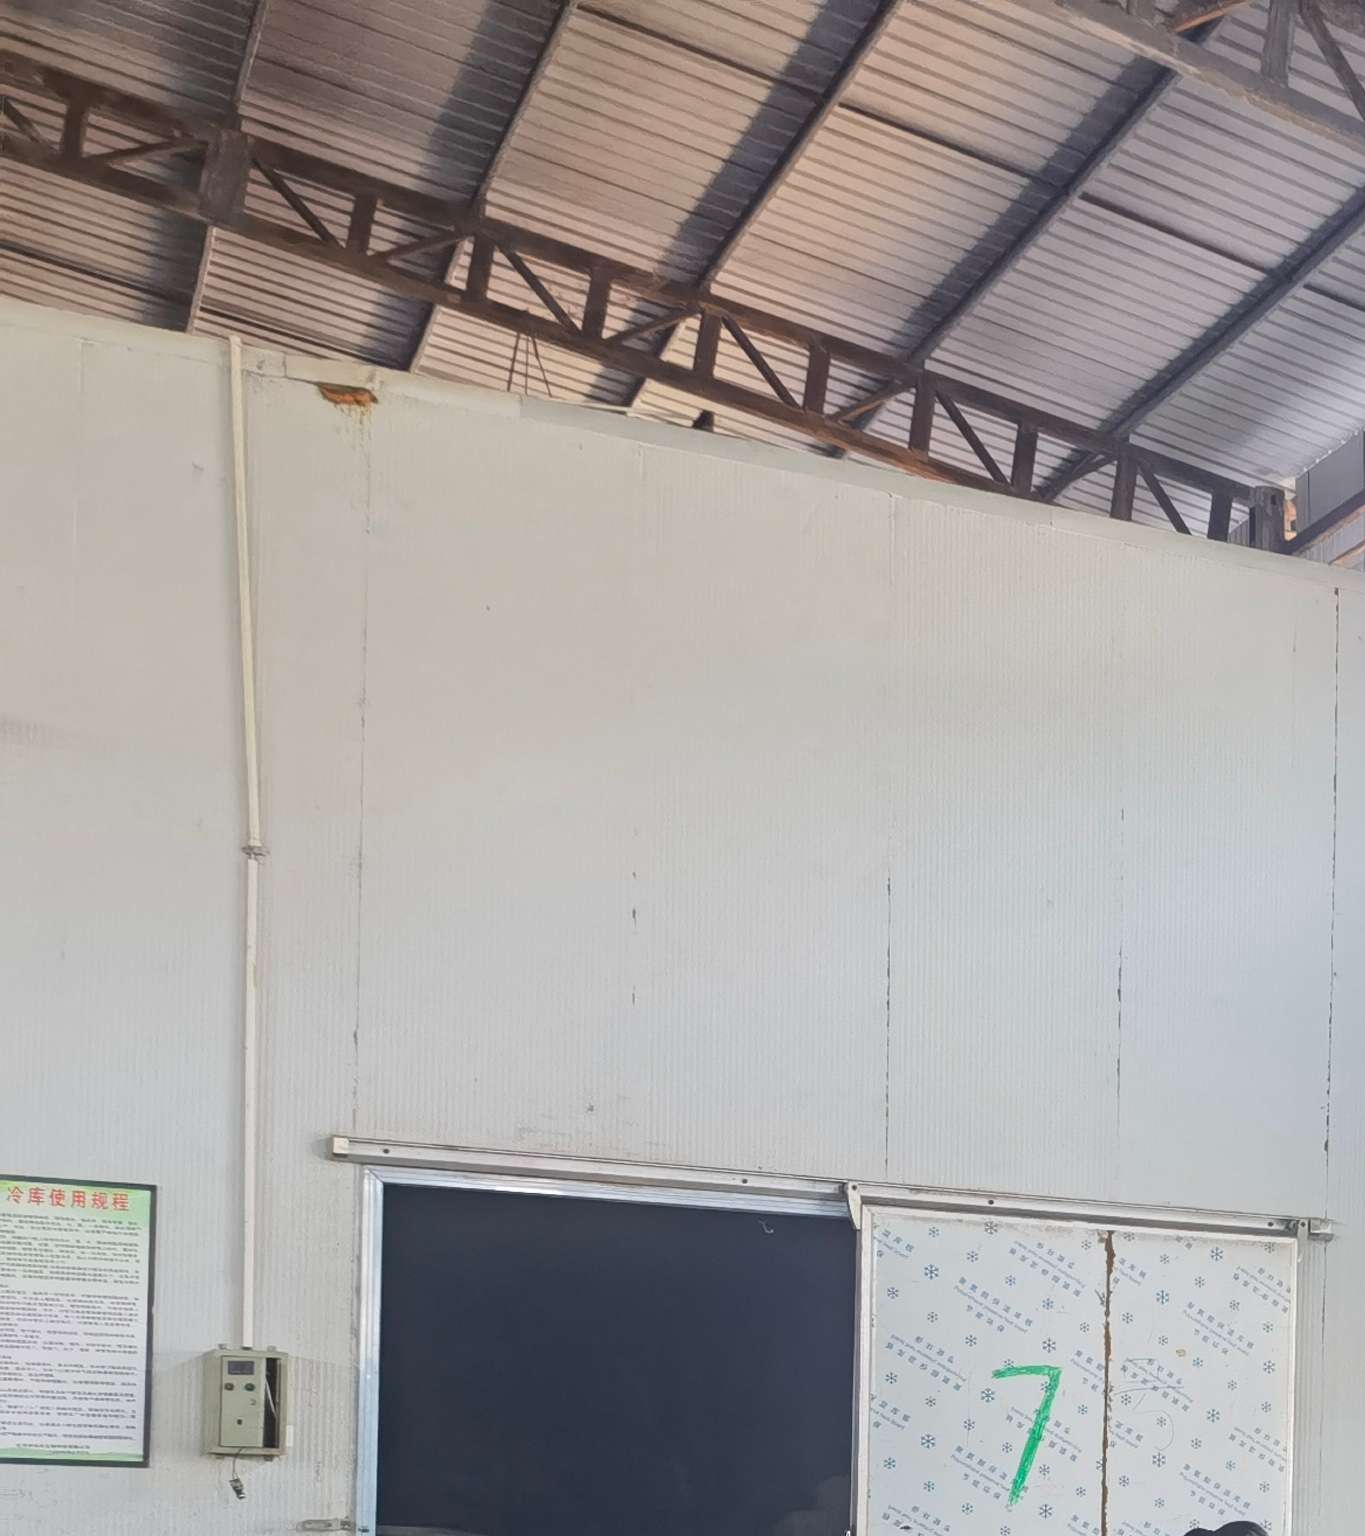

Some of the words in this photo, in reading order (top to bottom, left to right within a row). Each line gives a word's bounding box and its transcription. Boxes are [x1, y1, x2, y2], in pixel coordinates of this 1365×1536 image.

[7, 1186, 129, 1211] 冷库使用规程
[992, 1365, 1062, 1505] 7
